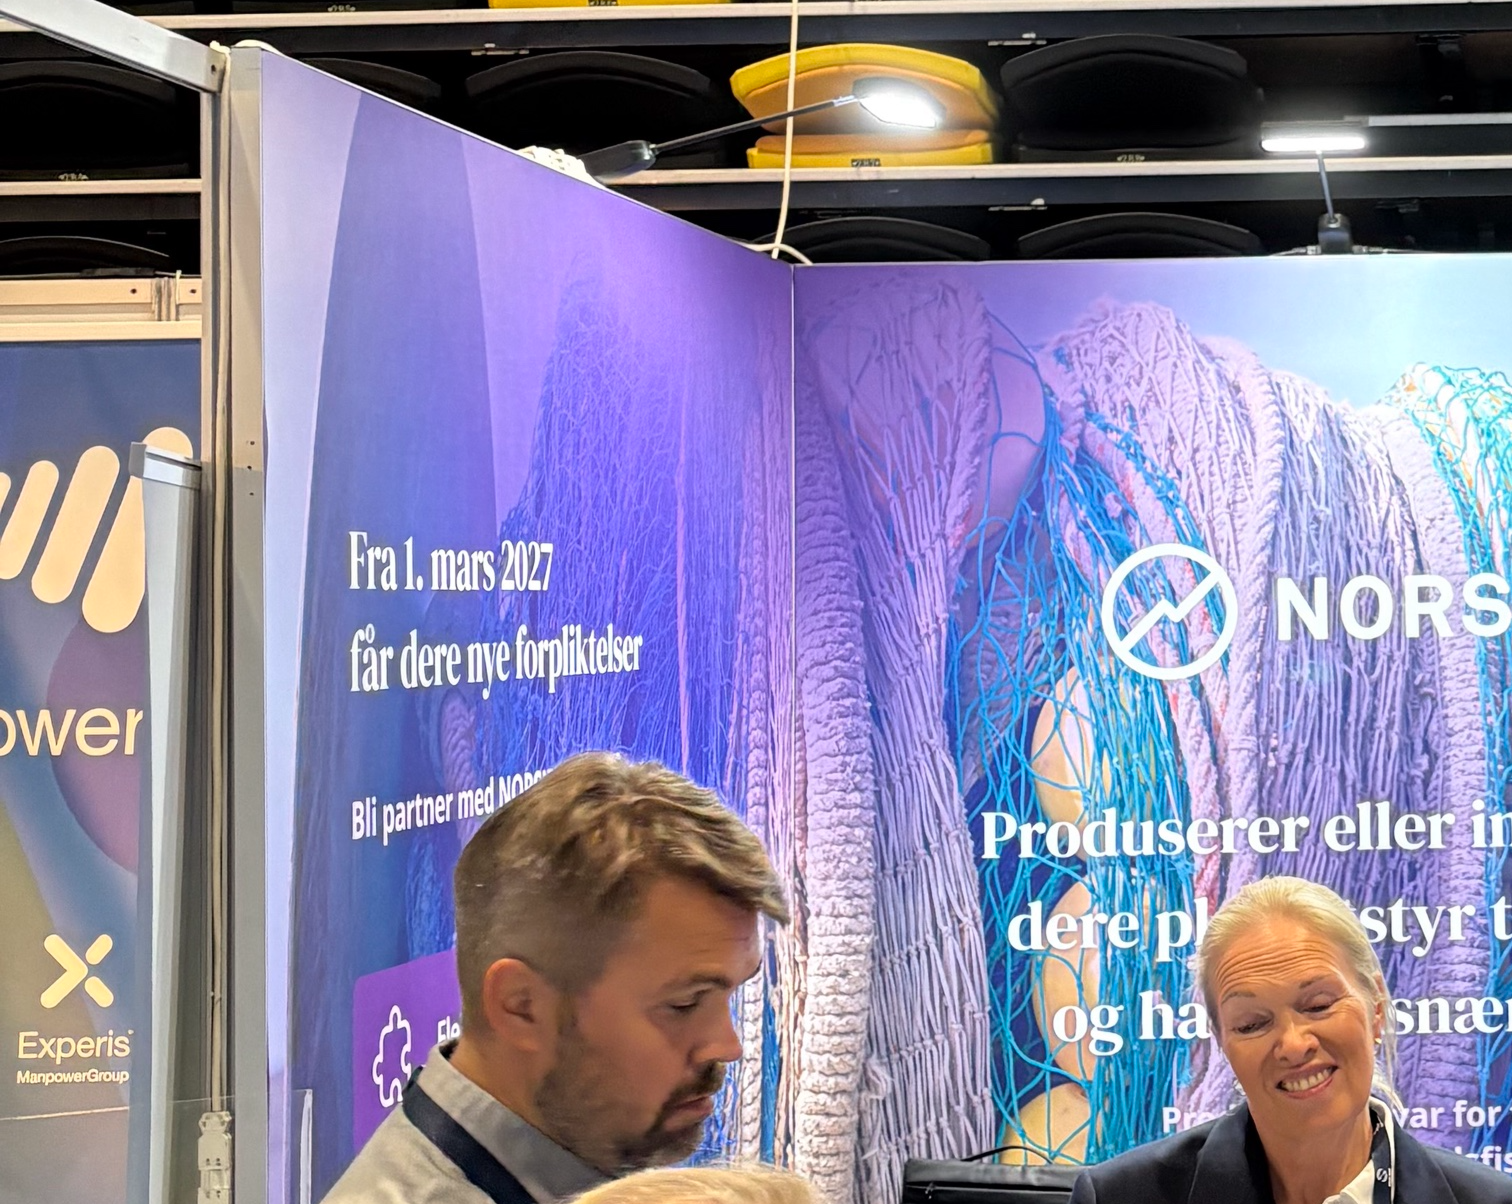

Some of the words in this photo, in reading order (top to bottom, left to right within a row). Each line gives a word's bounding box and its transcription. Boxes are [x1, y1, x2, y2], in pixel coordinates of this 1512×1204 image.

[349, 530, 398, 591] Fra
[403, 536, 424, 591] 1.
[430, 548, 496, 592] mars
[501, 539, 554, 592] 2027
[350, 623, 393, 692] får
[400, 628, 461, 689] dere
[467, 638, 510, 700] nye
[515, 623, 643, 694] forpliktelser
[352, 796, 377, 840] Bli
[382, 791, 453, 846] partner
[457, 776, 494, 820] med
[980, 808, 1310, 860] Produserer
[1323, 800, 1454, 853] eller
[1007, 900, 1140, 952] dere
[18, 1029, 131, 1065] Experis
[1053, 1002, 1124, 1057] og
[16, 1068, 130, 1086] ManpowerGroup
[1453, 1100, 1502, 1128] for
